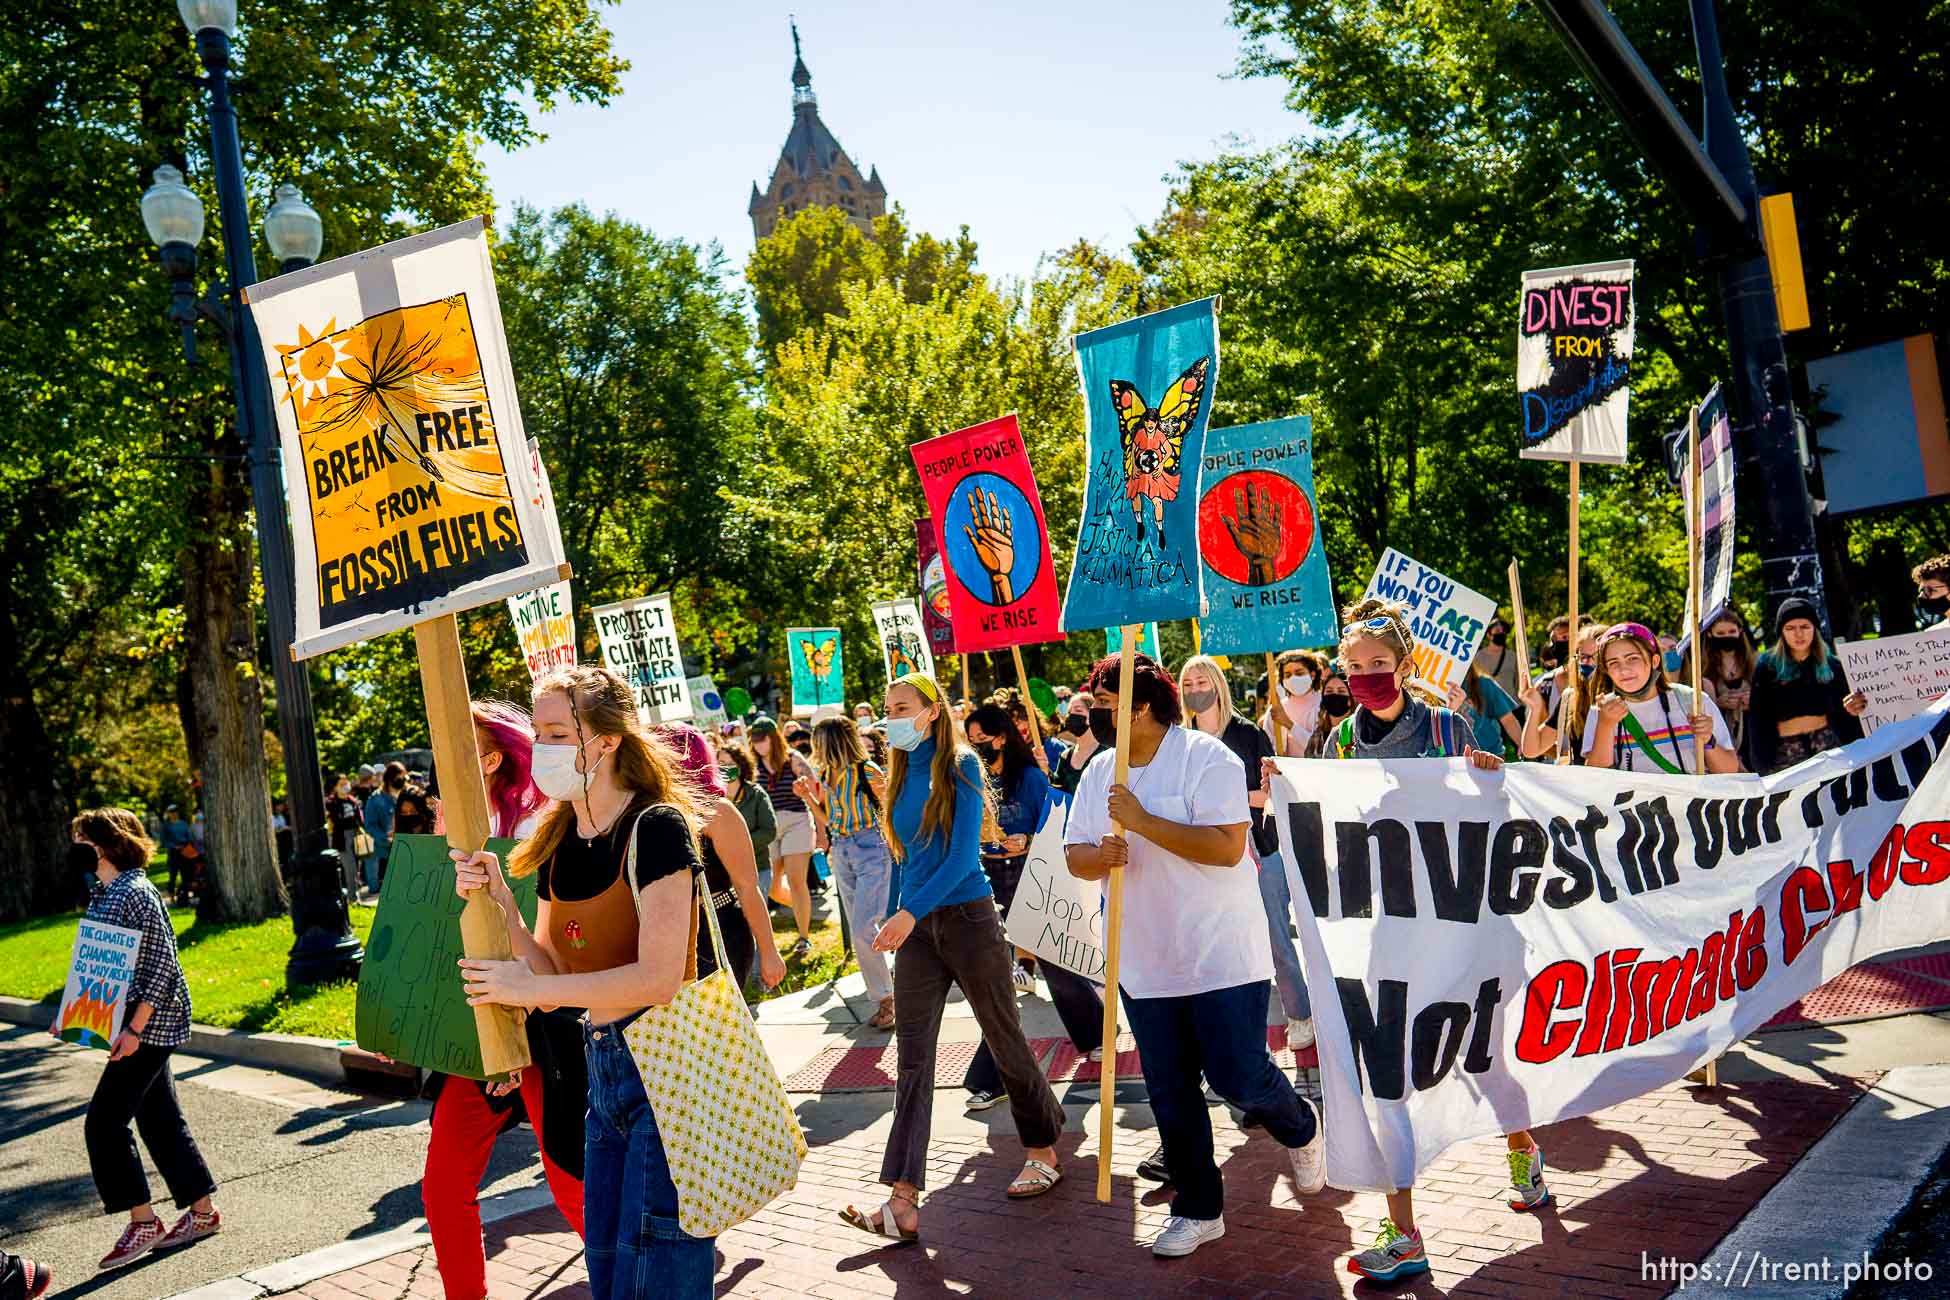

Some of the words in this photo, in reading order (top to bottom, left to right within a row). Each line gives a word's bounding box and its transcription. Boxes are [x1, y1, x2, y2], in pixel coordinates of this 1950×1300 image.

[1526, 286, 1629, 333] DIVEST
[1555, 335, 1602, 358] FROM
[313, 423, 398, 500] BREAK
[416, 406, 489, 454] FREE
[924, 451, 971, 479] PEOPLE
[973, 438, 1018, 465] POWER
[1202, 451, 1245, 472] OPLE
[1252, 439, 1308, 465] POWER
[375, 482, 441, 528] FROM
[1093, 490, 1118, 528] LA
[319, 530, 425, 606] FOSSIL
[423, 506, 519, 569] FUELS
[1081, 522, 1156, 563] JUSTICIA
[1385, 552, 1410, 576] IF
[1416, 566, 1454, 601] YOU
[519, 592, 562, 628] NTIVE
[1232, 592, 1253, 609] WE
[1260, 588, 1301, 605] RISE
[1377, 574, 1442, 620] WON'T
[1437, 608, 1483, 642] ACT
[599, 607, 664, 636] PROTECT
[623, 631, 648, 640] OUR
[980, 614, 999, 632] WE
[1003, 608, 1038, 628] RISE
[608, 637, 674, 665] CLIMATE
[1410, 616, 1473, 662] ADULTS
[1848, 652, 1869, 668] MY
[1875, 647, 1910, 660] METAL
[640, 683, 681, 708] ALTH
[1916, 684, 1950, 698] ANNU
[1287, 801, 1617, 924] Invest
[1612, 790, 1680, 895] in
[1687, 790, 1794, 870] our
[1025, 857, 1083, 932] Stop
[80, 925, 95, 939] THE
[95, 929, 125, 945] CLIMATE
[126, 934, 136, 948] IS
[74, 959, 87, 973] SO
[90, 962, 110, 978] WHY
[79, 944, 127, 967] CHANGING
[78, 975, 120, 1005] YOU
[1333, 977, 1504, 1099] Not
[1516, 903, 1767, 1065] Climate
